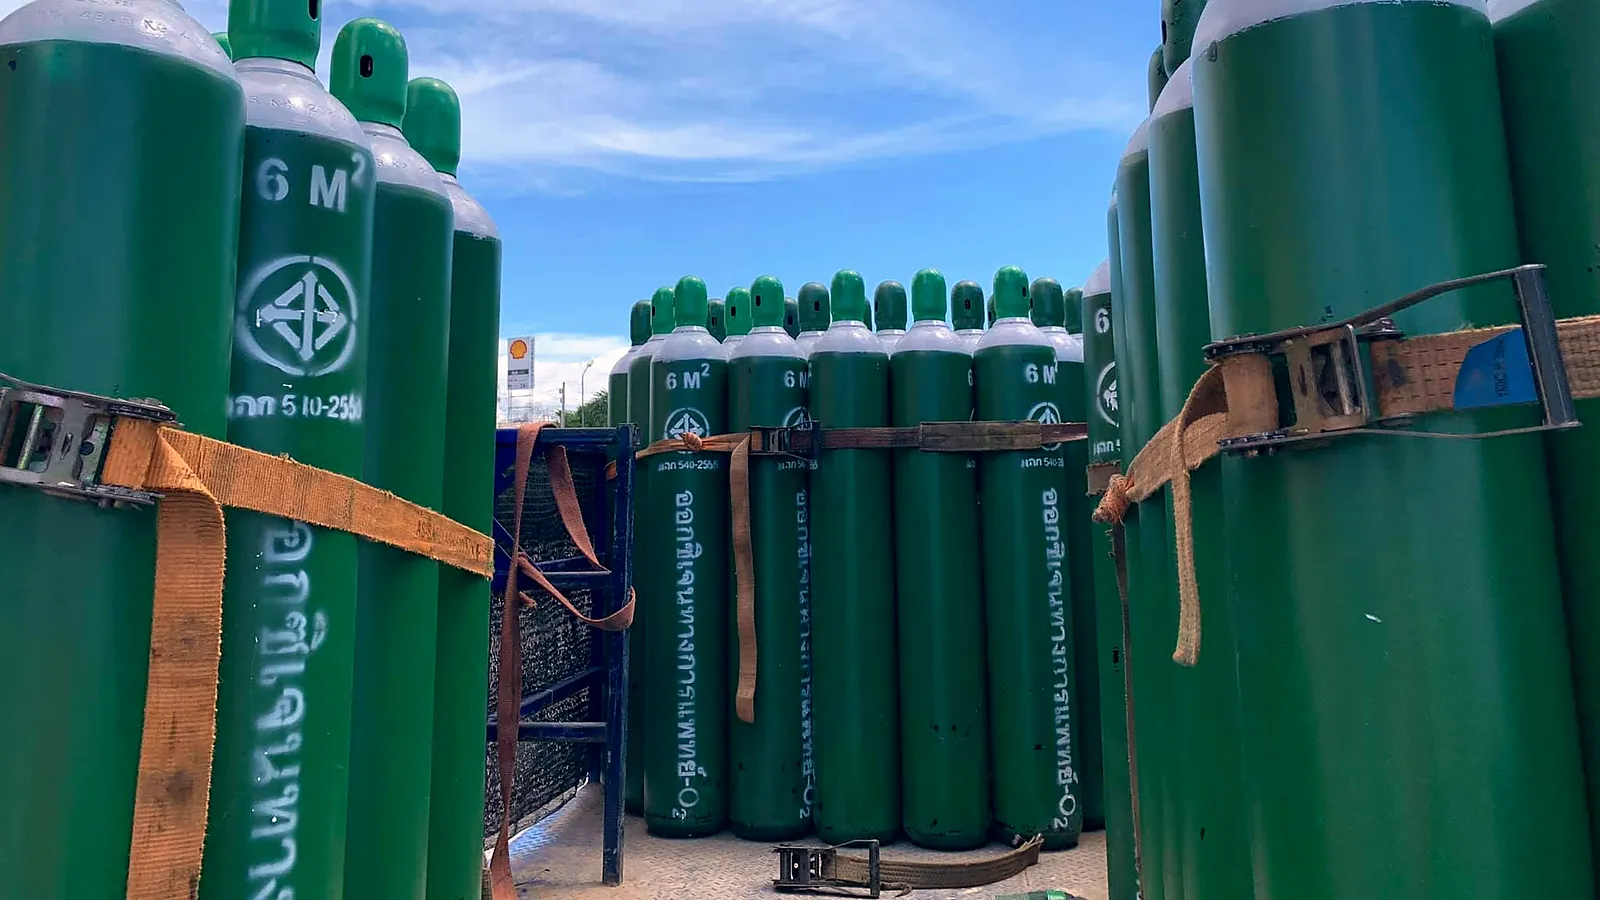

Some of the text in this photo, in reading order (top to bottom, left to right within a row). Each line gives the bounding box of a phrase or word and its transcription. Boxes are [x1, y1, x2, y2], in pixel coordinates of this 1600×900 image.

[258, 157, 289, 201] 6
[1095, 307, 1110, 334] 6
[666, 372, 677, 390] 6
[784, 369, 796, 388] 6
[1025, 363, 1039, 384] 6
